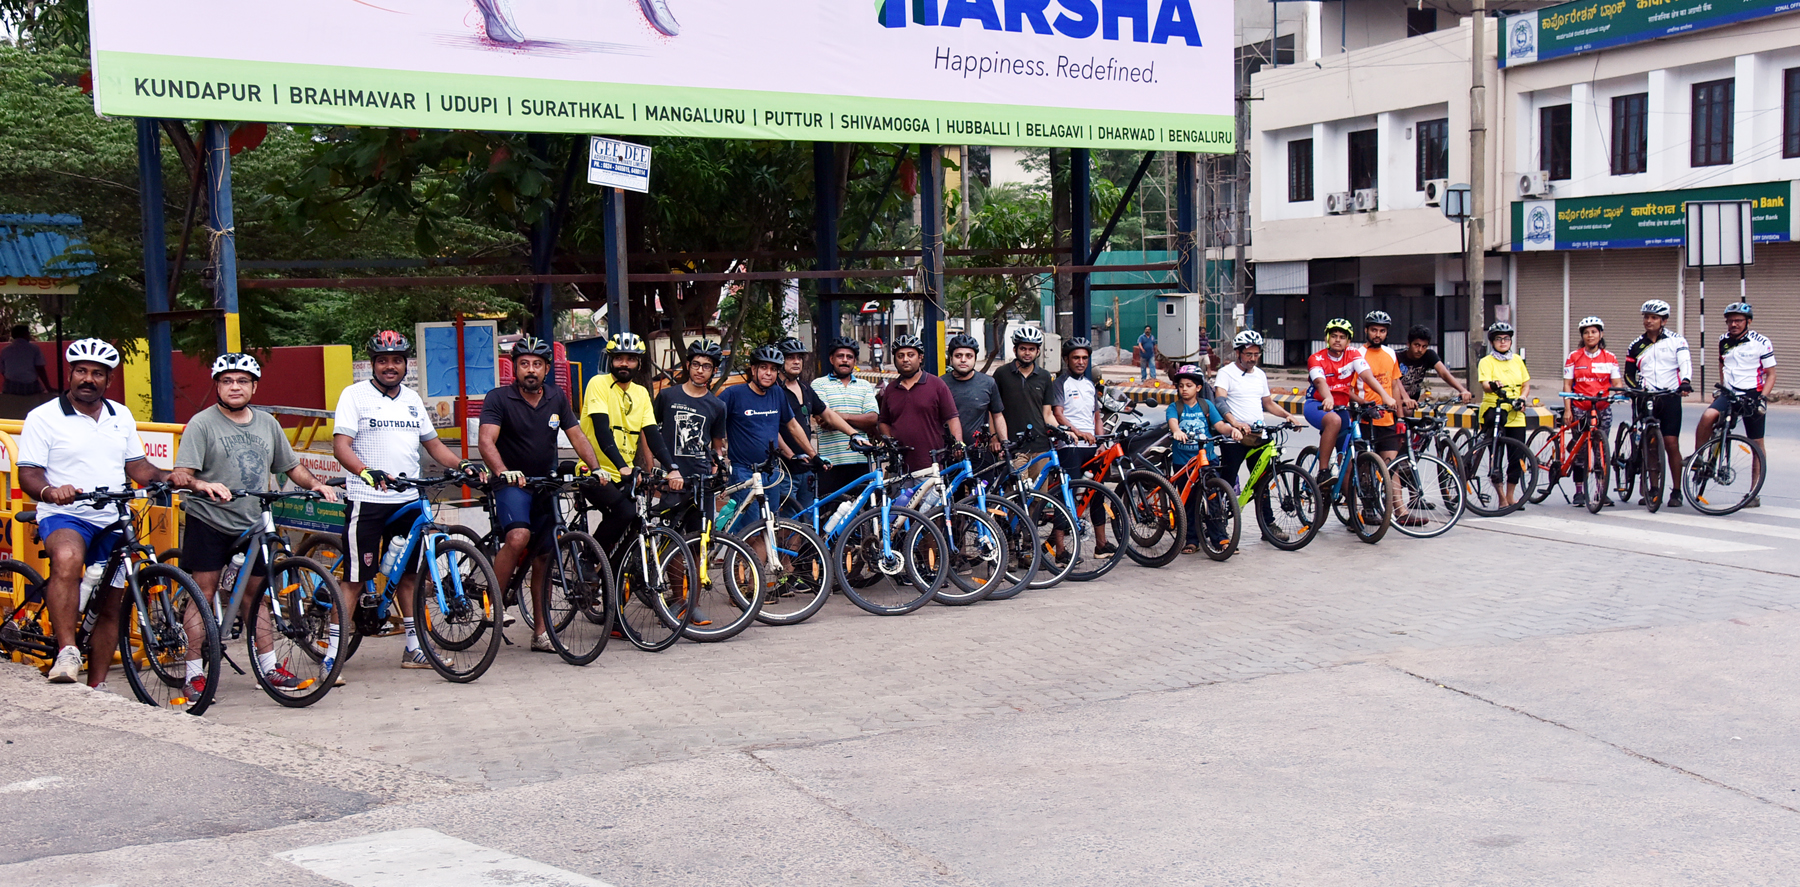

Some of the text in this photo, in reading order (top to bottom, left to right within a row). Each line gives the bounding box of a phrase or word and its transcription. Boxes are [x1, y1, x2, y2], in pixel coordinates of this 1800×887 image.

[934, 46, 1158, 84] Happiness. Redefined.
[134, 77, 1233, 145] KUNDAPUR BRAHMAVAR UDUPI SURATHKAL MANGALURU PUTTUR SHIVAMOGGA HUBBALLI BELAGAVI DHARWAD BENGALURU
[594, 141, 647, 162] GEE DEE
[1760, 195, 1785, 208] Bank
[369, 418, 420, 429] SOUTHDALE
[144, 443, 168, 458] OLICE
[299, 457, 342, 473] MANGALURU
